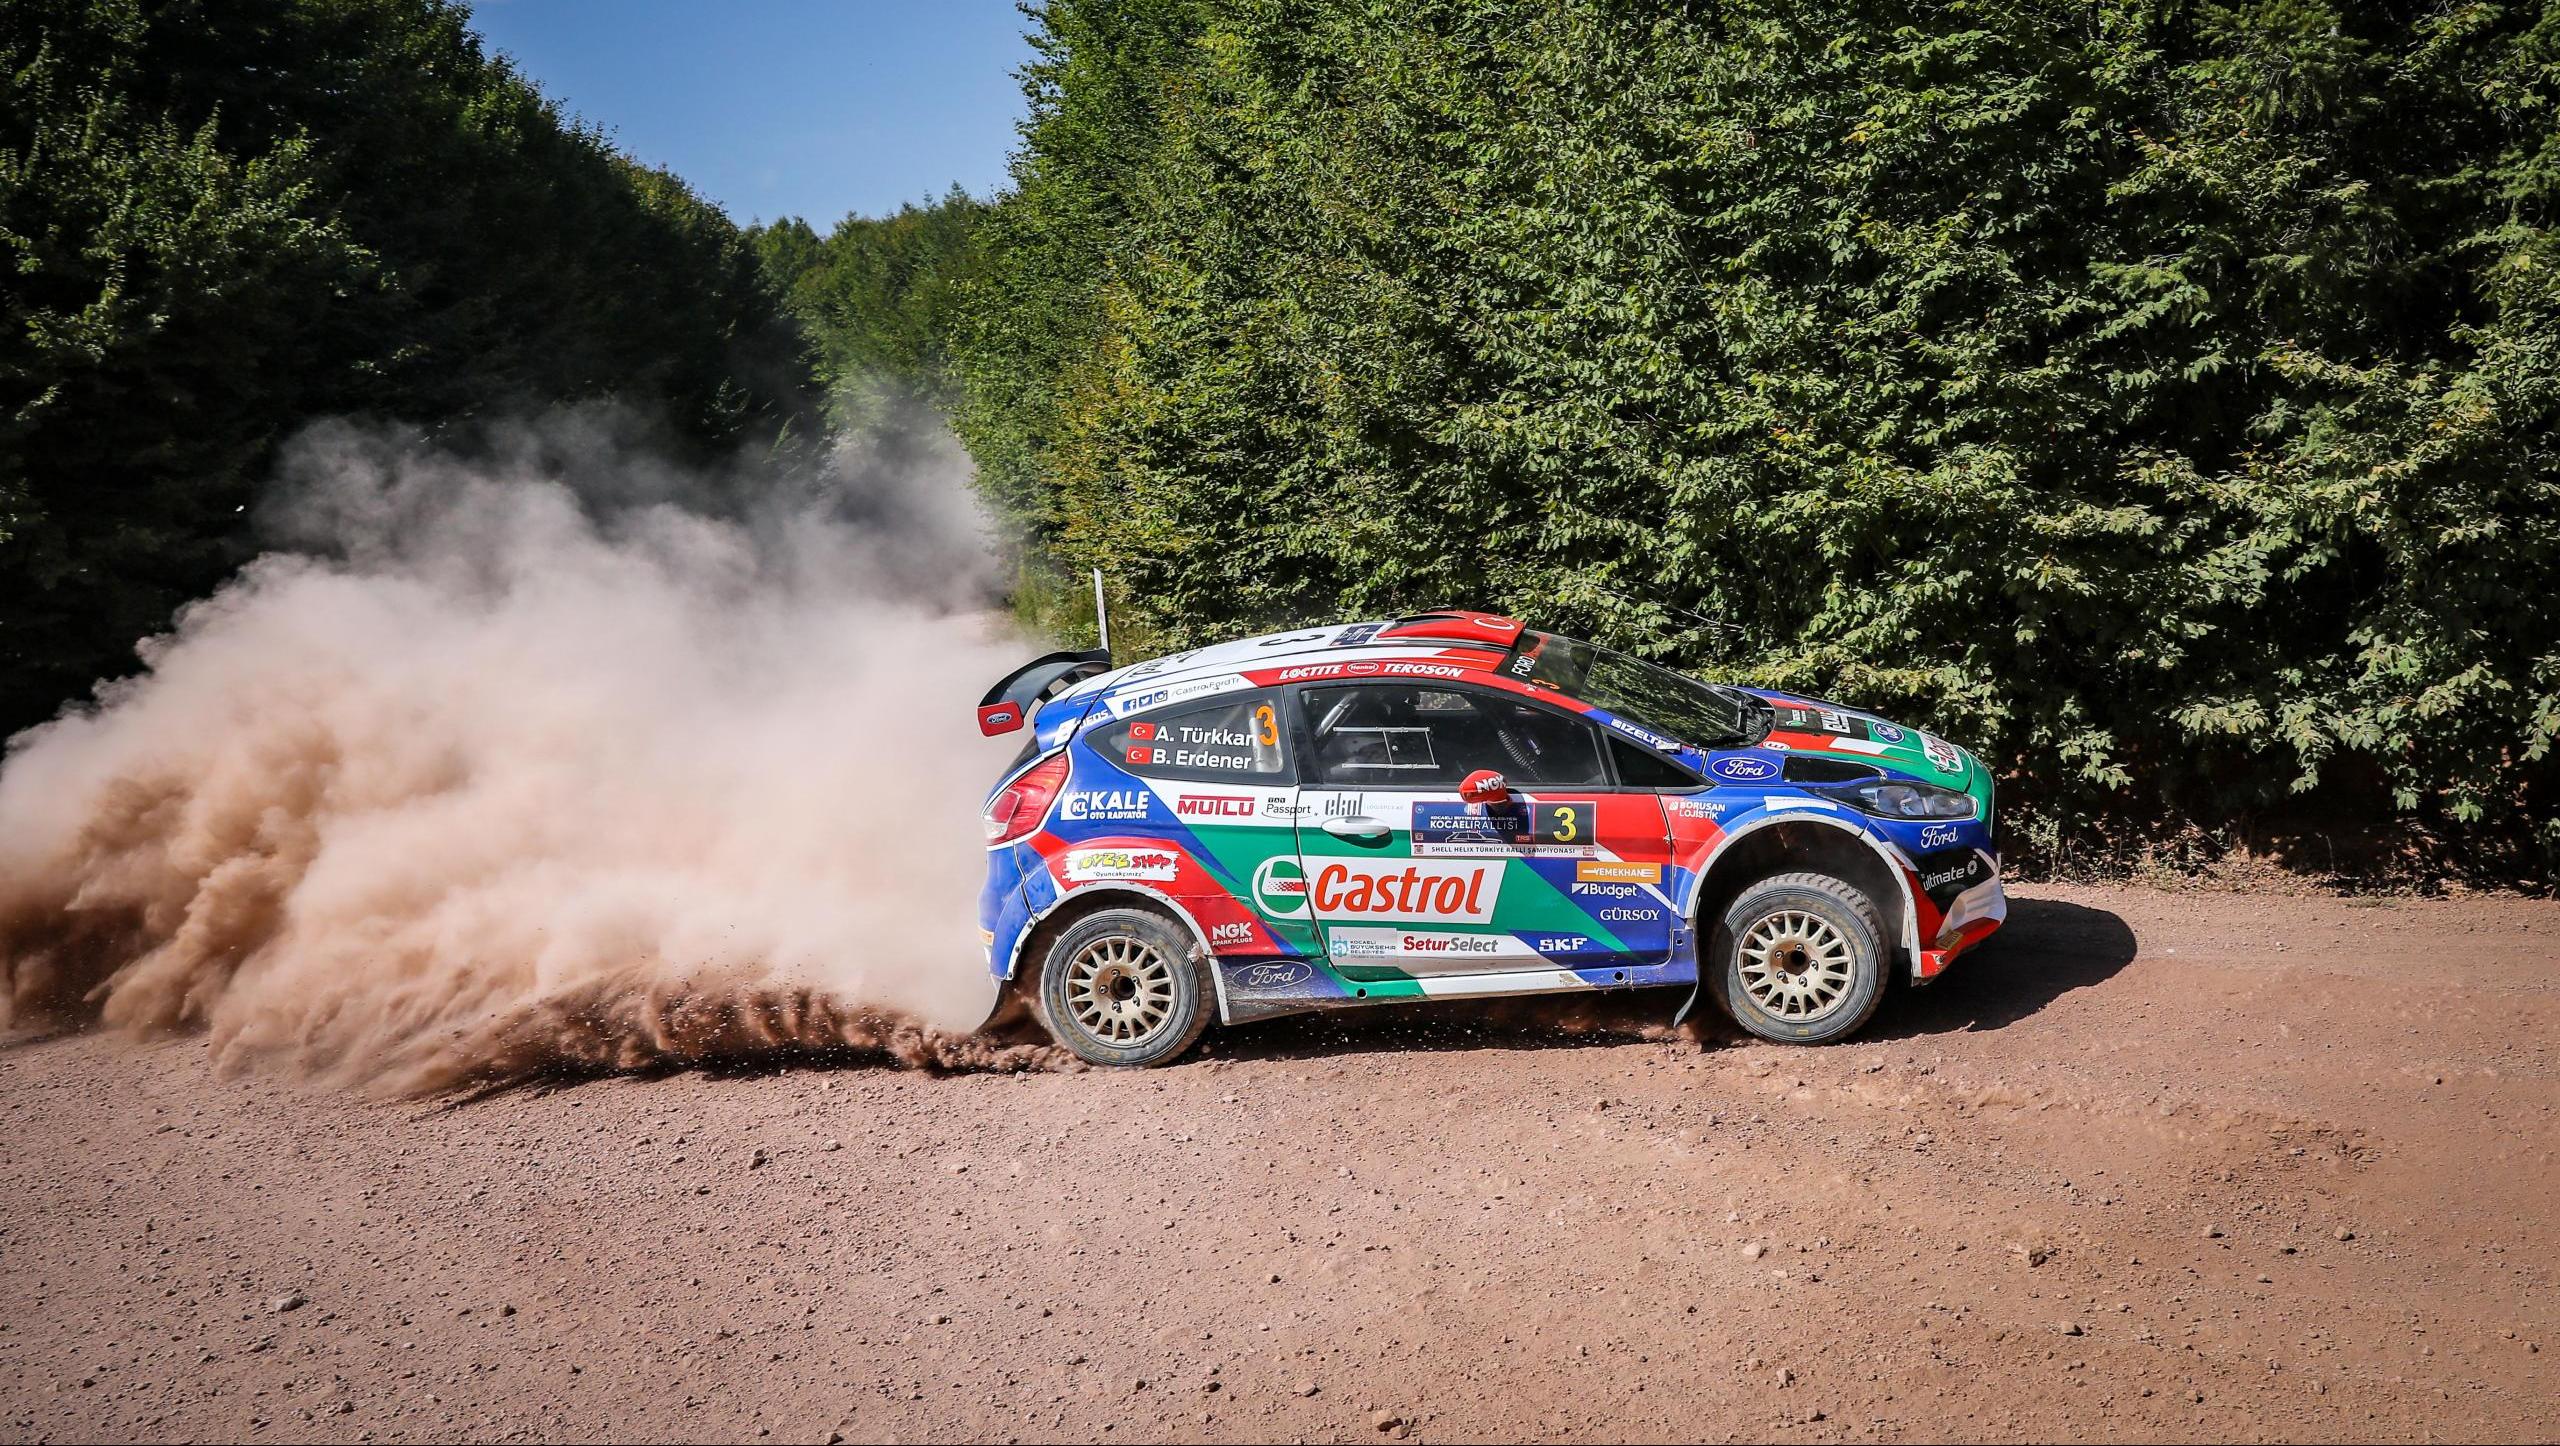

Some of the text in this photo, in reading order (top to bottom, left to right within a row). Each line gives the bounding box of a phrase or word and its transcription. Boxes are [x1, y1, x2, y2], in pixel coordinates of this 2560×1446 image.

[1279, 664, 1343, 680] LOCTITE
[1349, 664, 1376, 672] Henkel
[1383, 663, 1464, 678] TEROSON
[1511, 655, 1536, 677] FORD
[1254, 704, 1279, 747] 3
[1154, 726, 1257, 748] A. Türkkan
[1152, 749, 1252, 770] B. Erdener
[1724, 758, 1765, 777] Ford
[1474, 774, 1507, 793] NGK
[1090, 790, 1150, 810] KALE
[1177, 794, 1256, 817] MUTLU
[1266, 803, 1312, 816] Passport
[1680, 801, 1726, 812] BORUSAN
[1090, 810, 1147, 820] OTO RADYATÖR
[1552, 806, 1578, 843] 3
[1920, 824, 1959, 849] Ford
[1131, 853, 1172, 870] SHOP
[1314, 863, 1485, 915] Castrol
[1589, 883, 1638, 900] Budget
[1600, 907, 1661, 921] GÜRSOY
[1211, 921, 1253, 940] NGK
[1538, 937, 1588, 952] SKF
[1248, 963, 1296, 986] Ford
